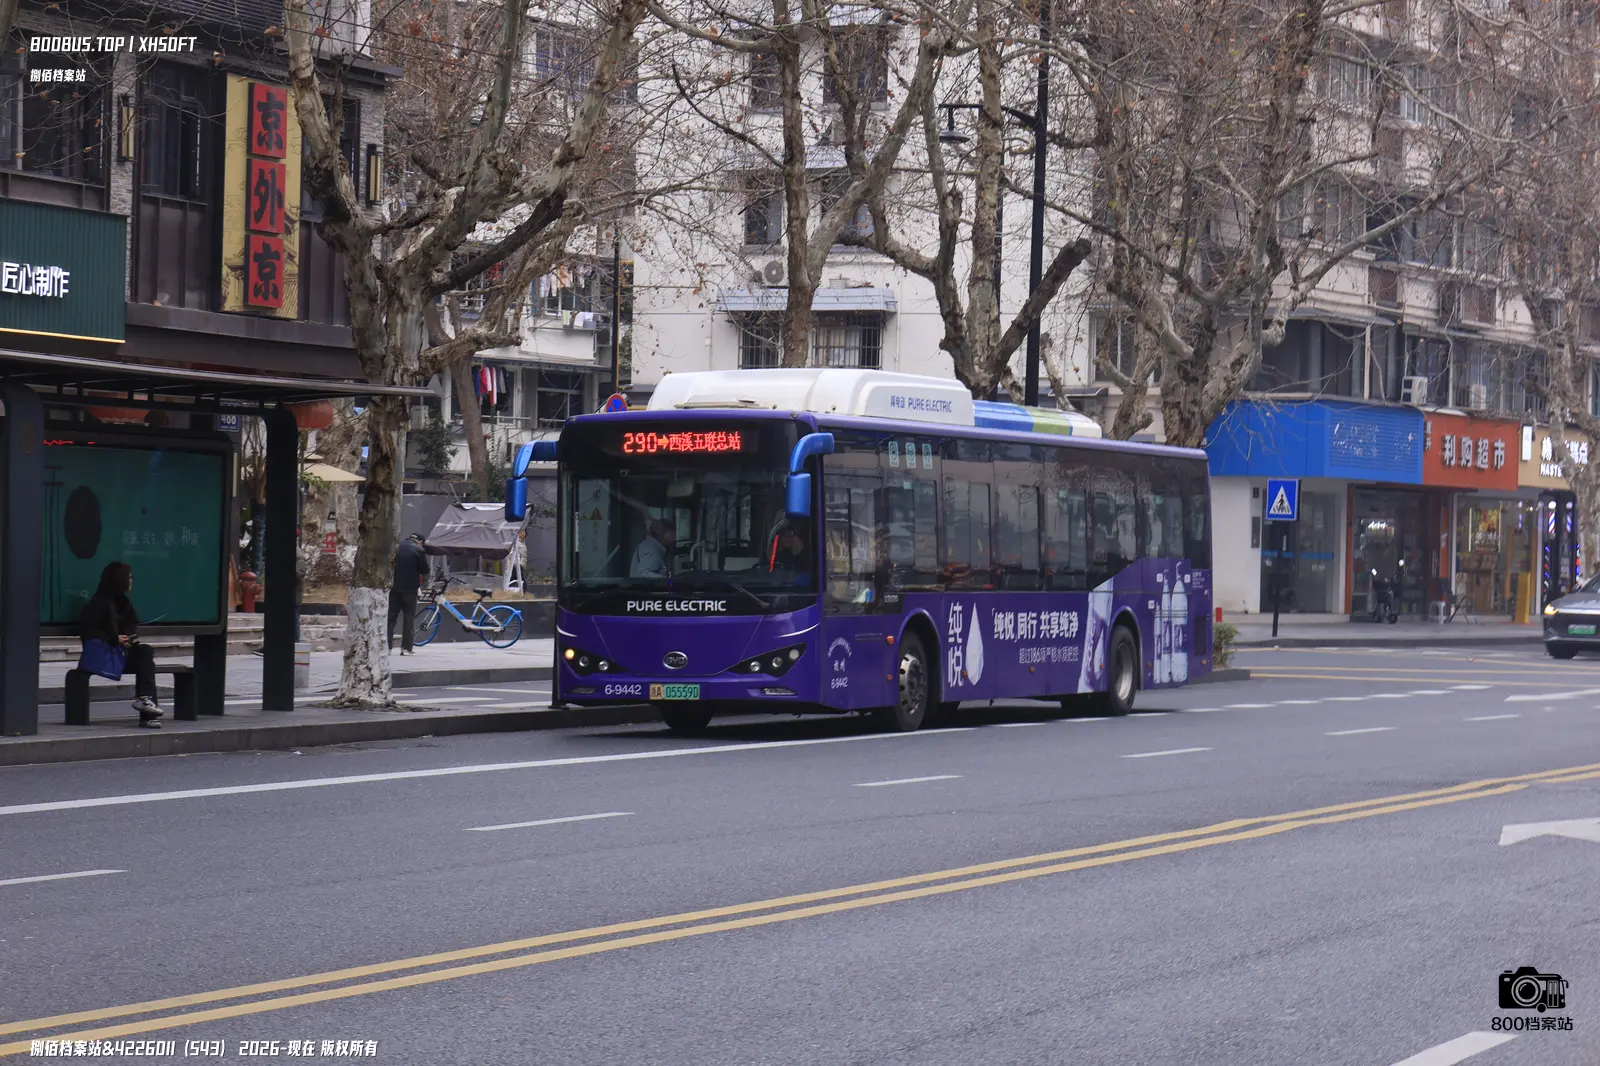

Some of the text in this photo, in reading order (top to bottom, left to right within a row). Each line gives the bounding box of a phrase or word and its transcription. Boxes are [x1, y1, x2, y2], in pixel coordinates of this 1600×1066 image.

[253, 91, 285, 302] 京外京
[2, 262, 70, 298] 匠心制作
[908, 397, 953, 412] PURE ELECTRIC
[624, 431, 741, 453] 290 西溪五联总站
[1443, 434, 1506, 470] 利购超市
[627, 600, 727, 611] PURE ELECTRIC
[1040, 611, 1079, 639] 共享纯净
[947, 602, 964, 688] 纯悦
[604, 684, 642, 695] 6-9442
